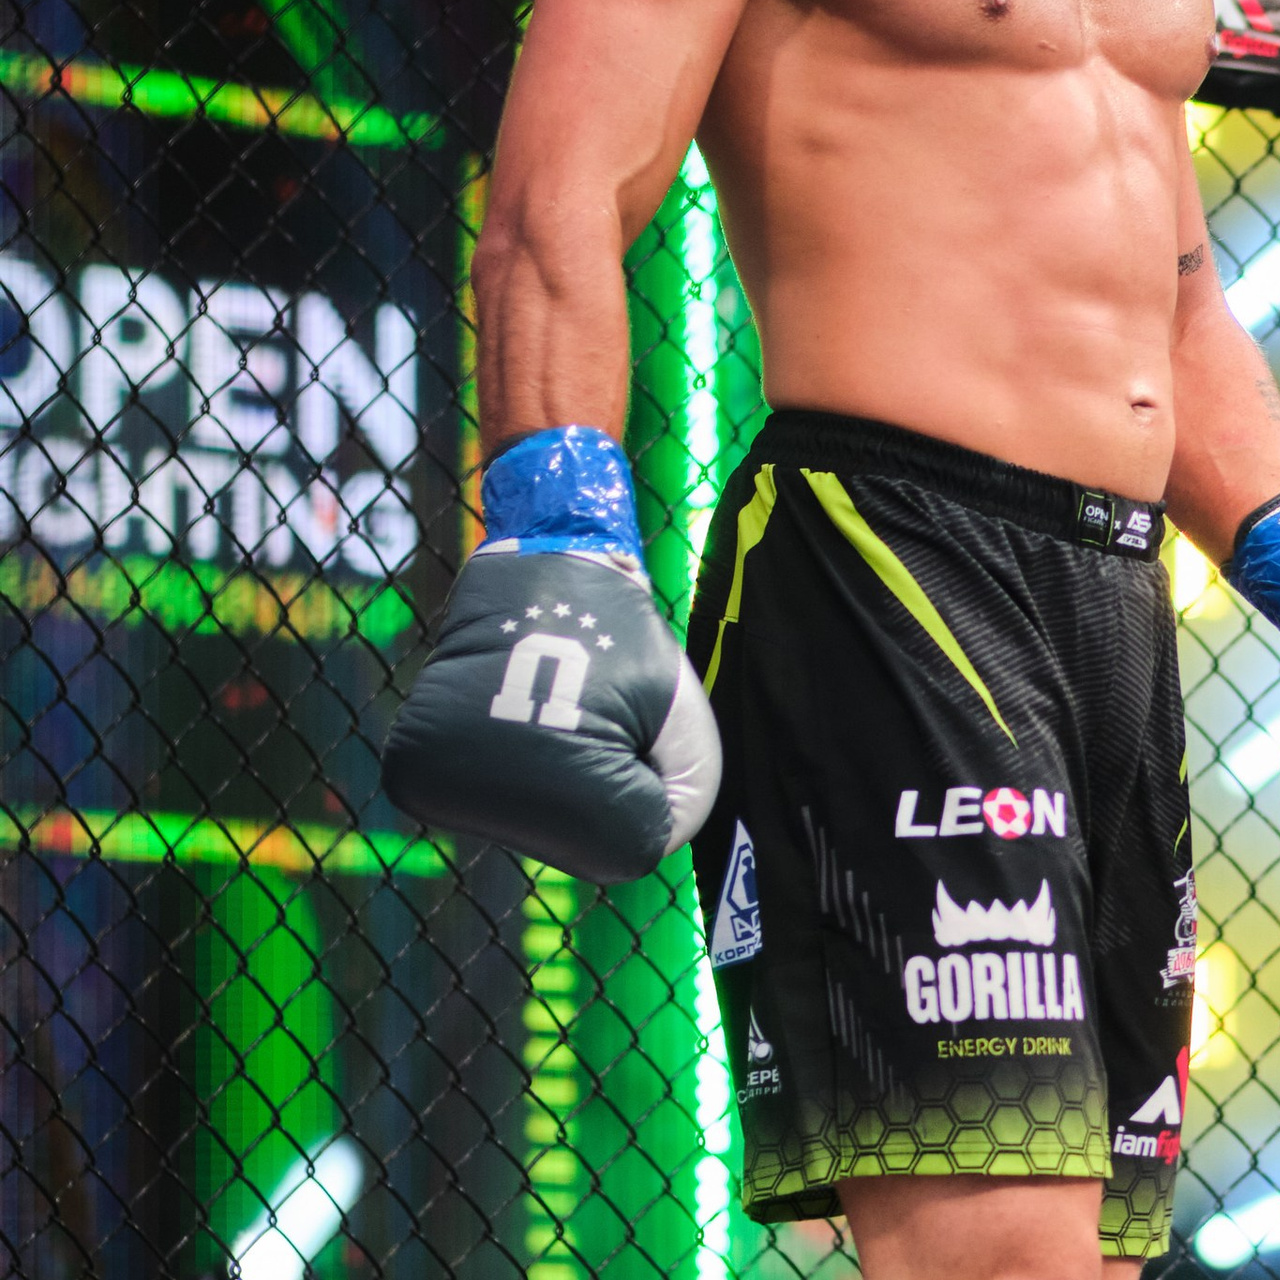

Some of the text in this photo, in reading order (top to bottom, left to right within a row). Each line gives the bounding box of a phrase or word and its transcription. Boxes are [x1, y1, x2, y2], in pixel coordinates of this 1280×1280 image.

[895, 786, 1067, 840] LEON
[904, 952, 1085, 1024] GORILLA
[937, 1036, 1072, 1058] ENERGY DRINK
